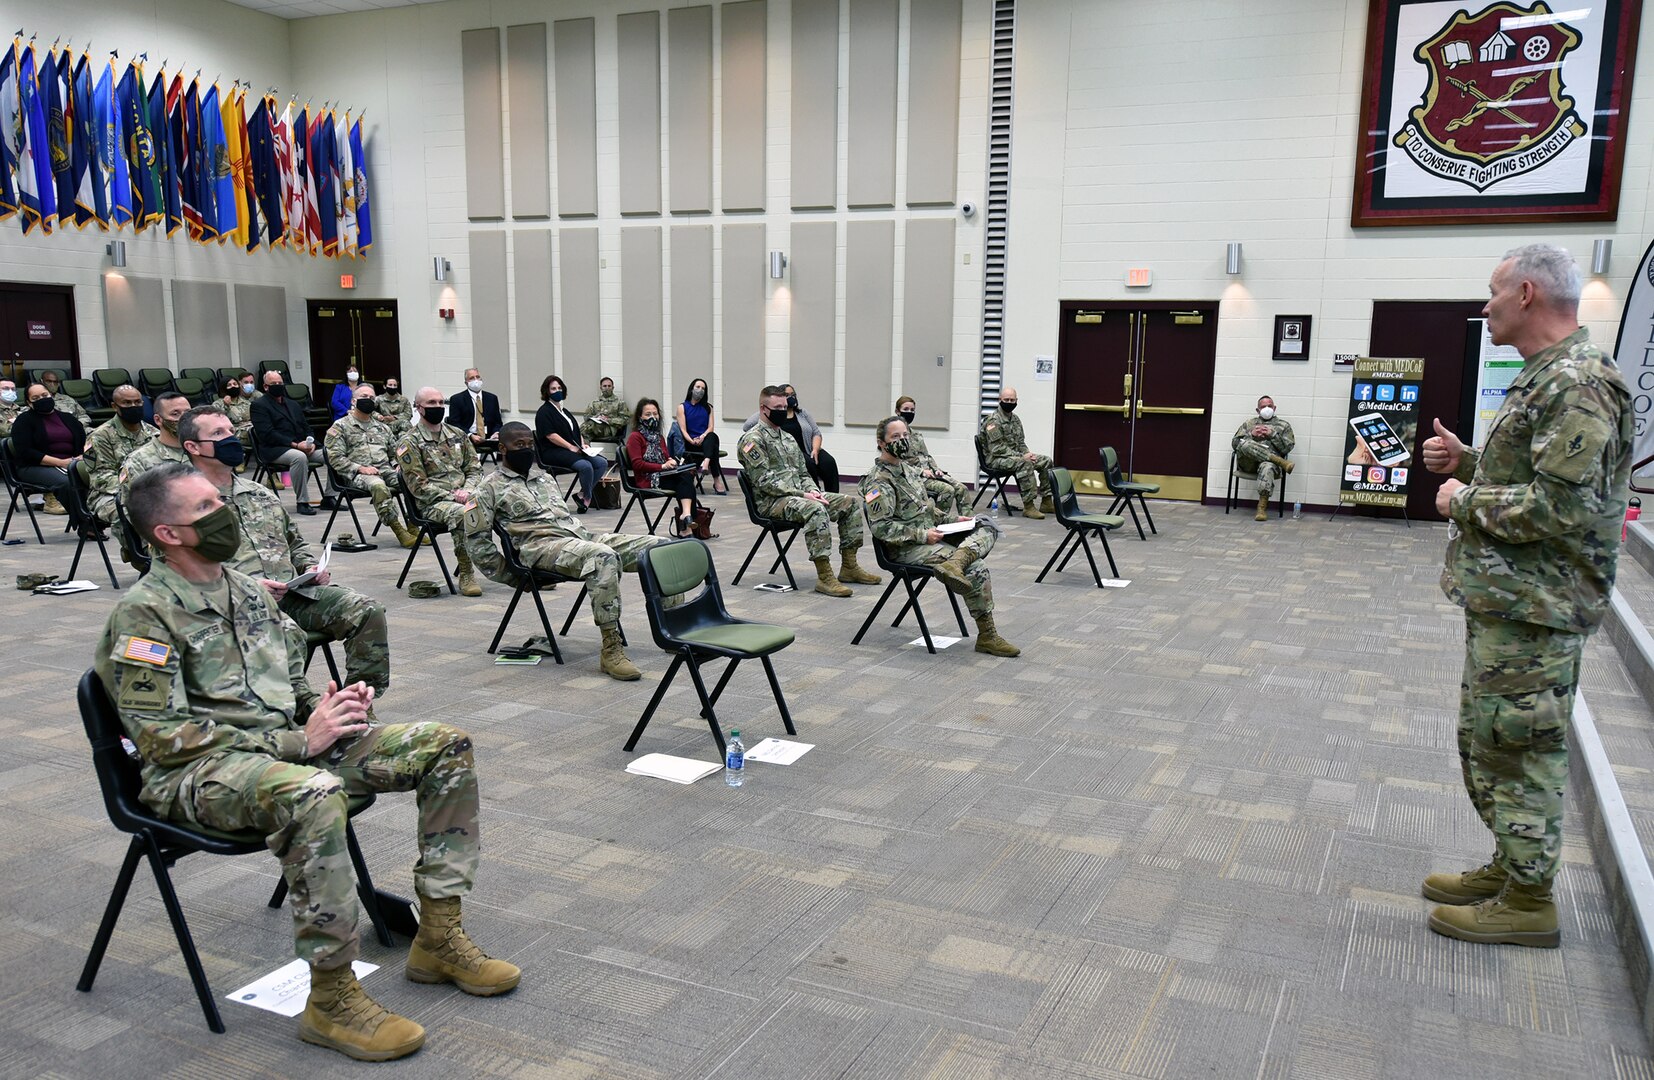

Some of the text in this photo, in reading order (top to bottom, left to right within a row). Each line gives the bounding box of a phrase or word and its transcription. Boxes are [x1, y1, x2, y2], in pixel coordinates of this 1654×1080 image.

[1408, 130, 1569, 183] TO CONSERVE FIGHTING STRENGTH
[1129, 269, 1149, 284] EXIT
[1354, 359, 1424, 373] Connect with MEDCoE
[1371, 371, 1404, 379] #MEDCoE
[1402, 387, 1416, 400] in
[1357, 401, 1412, 412] @MedicalCoE
[1353, 482, 1398, 492] @MEDCoE
[1340, 492, 1407, 507] www.MEDCoE.army.mil
